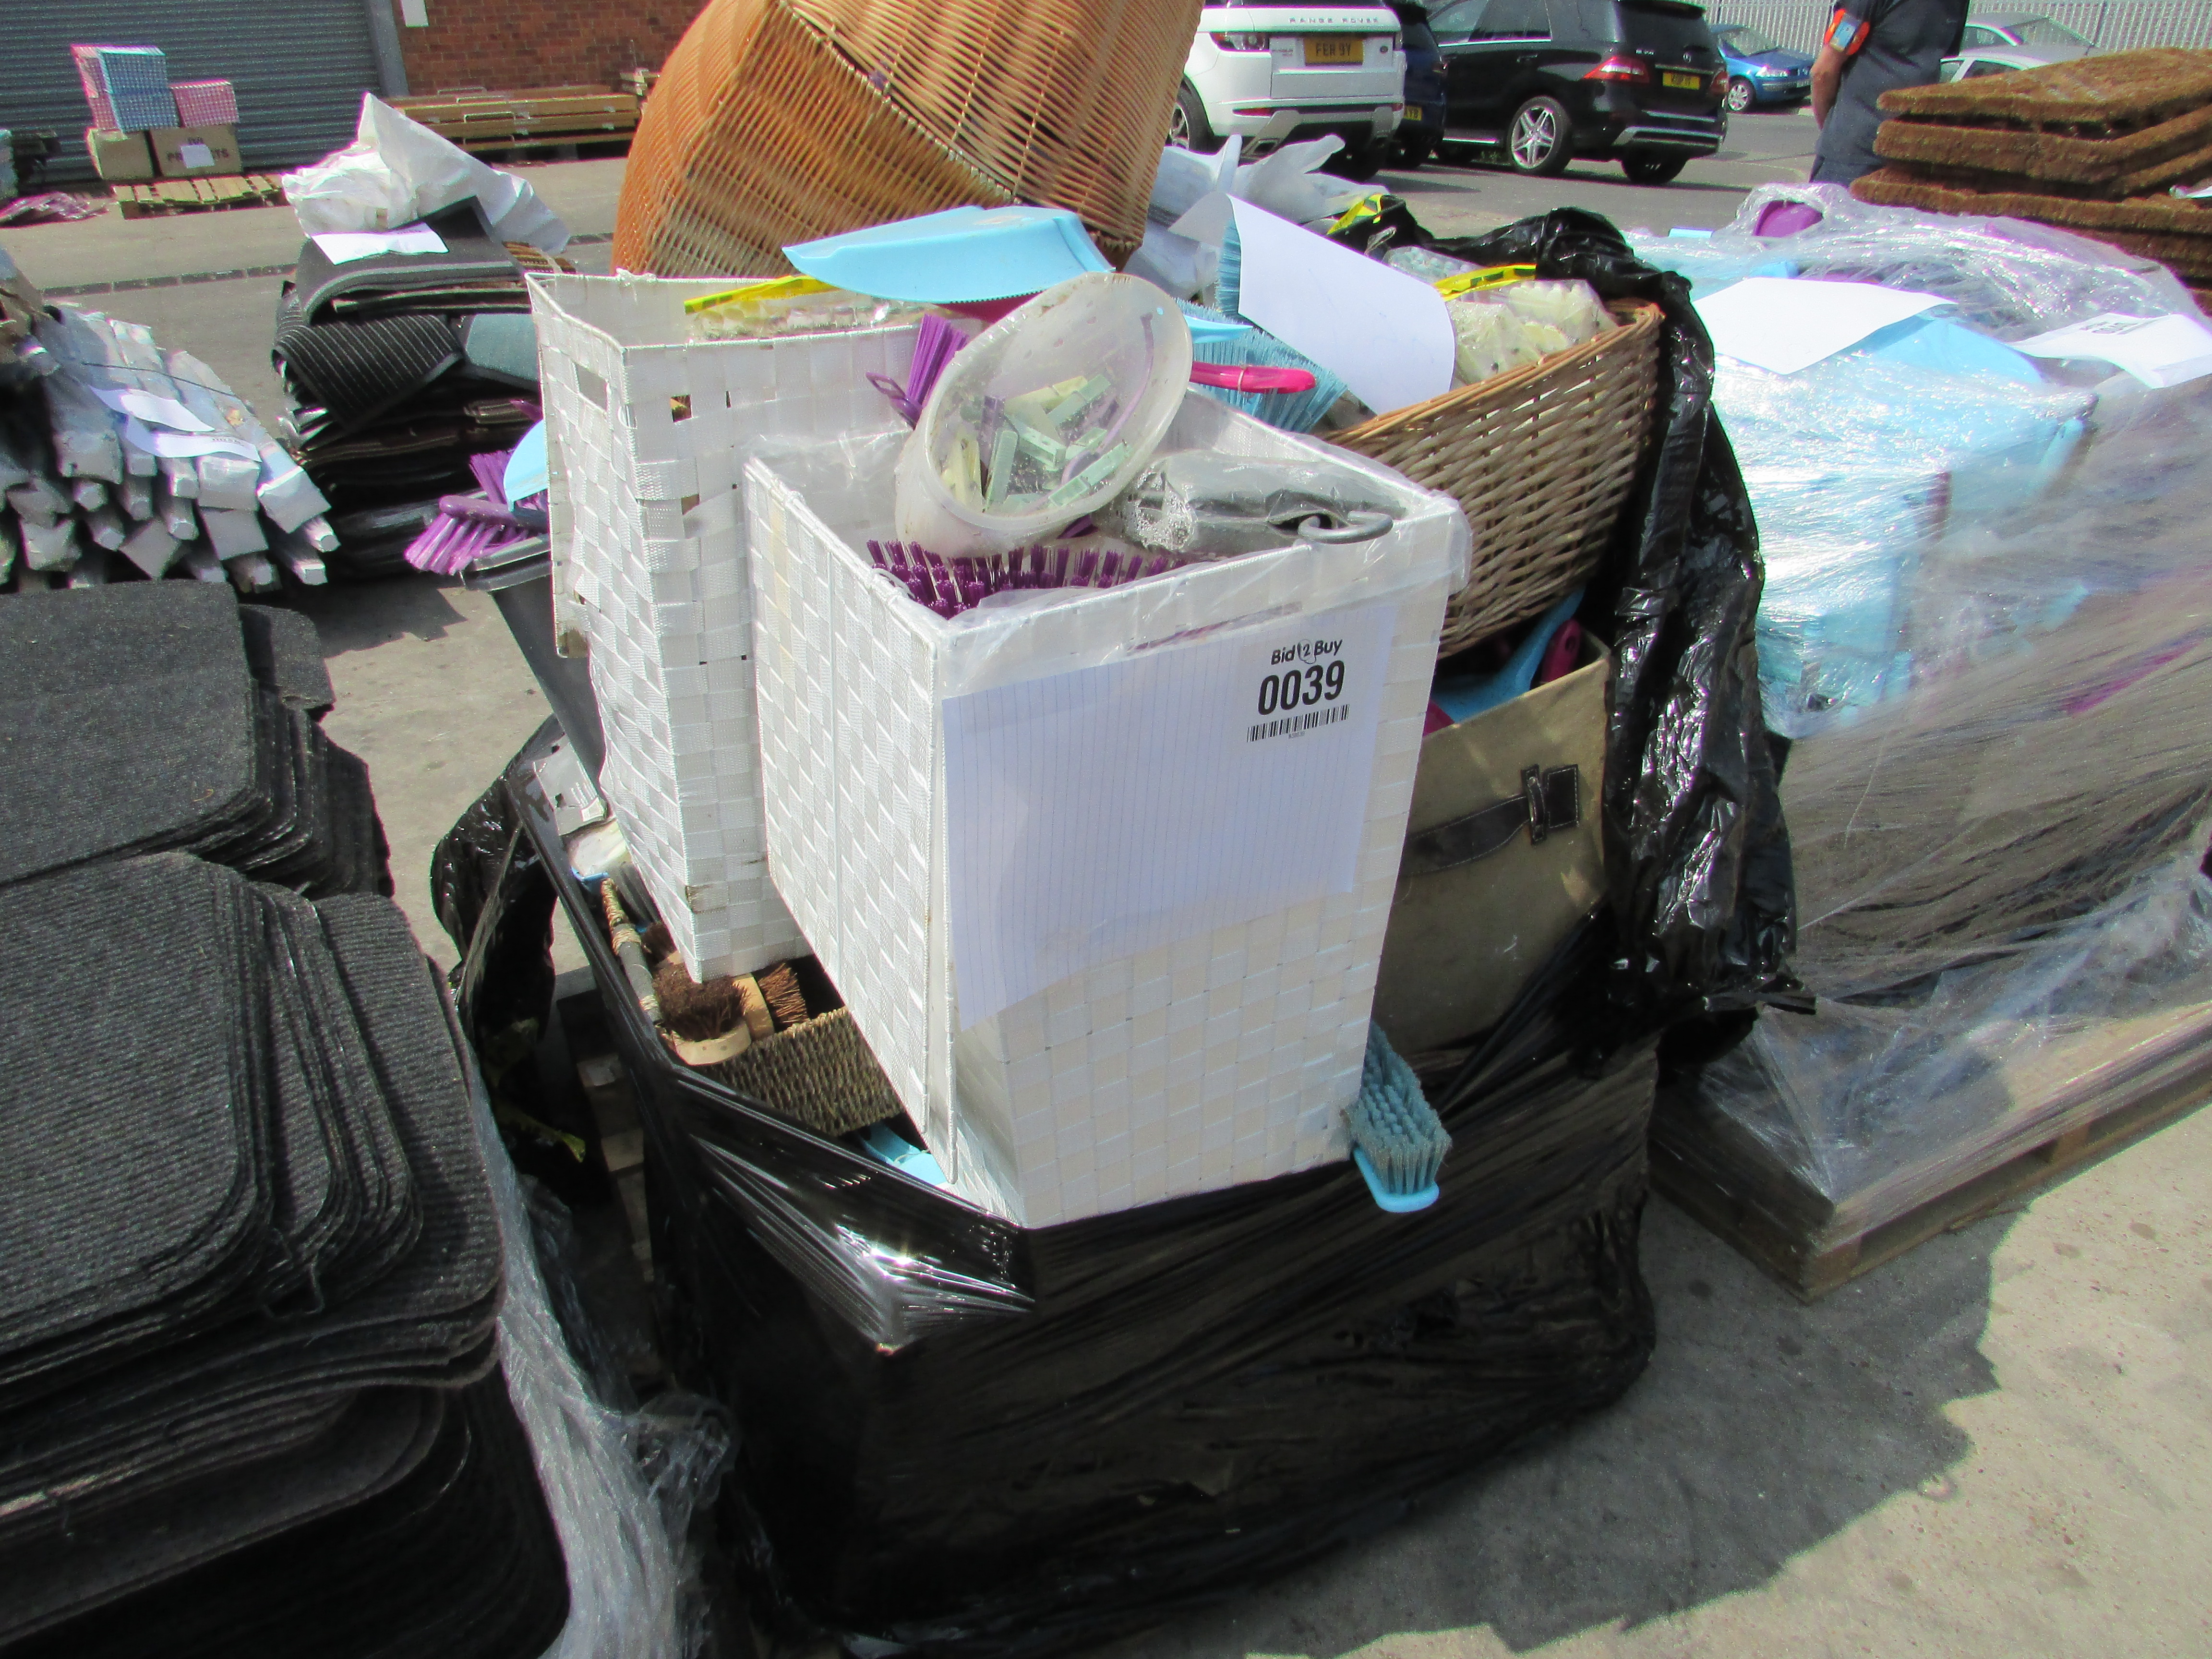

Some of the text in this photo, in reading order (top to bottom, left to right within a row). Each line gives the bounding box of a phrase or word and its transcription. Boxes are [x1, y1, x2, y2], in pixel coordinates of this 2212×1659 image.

[1272, 645, 1295, 665] Bid
[1314, 639, 1343, 656] Buy
[1258, 660, 1345, 715] 0039
